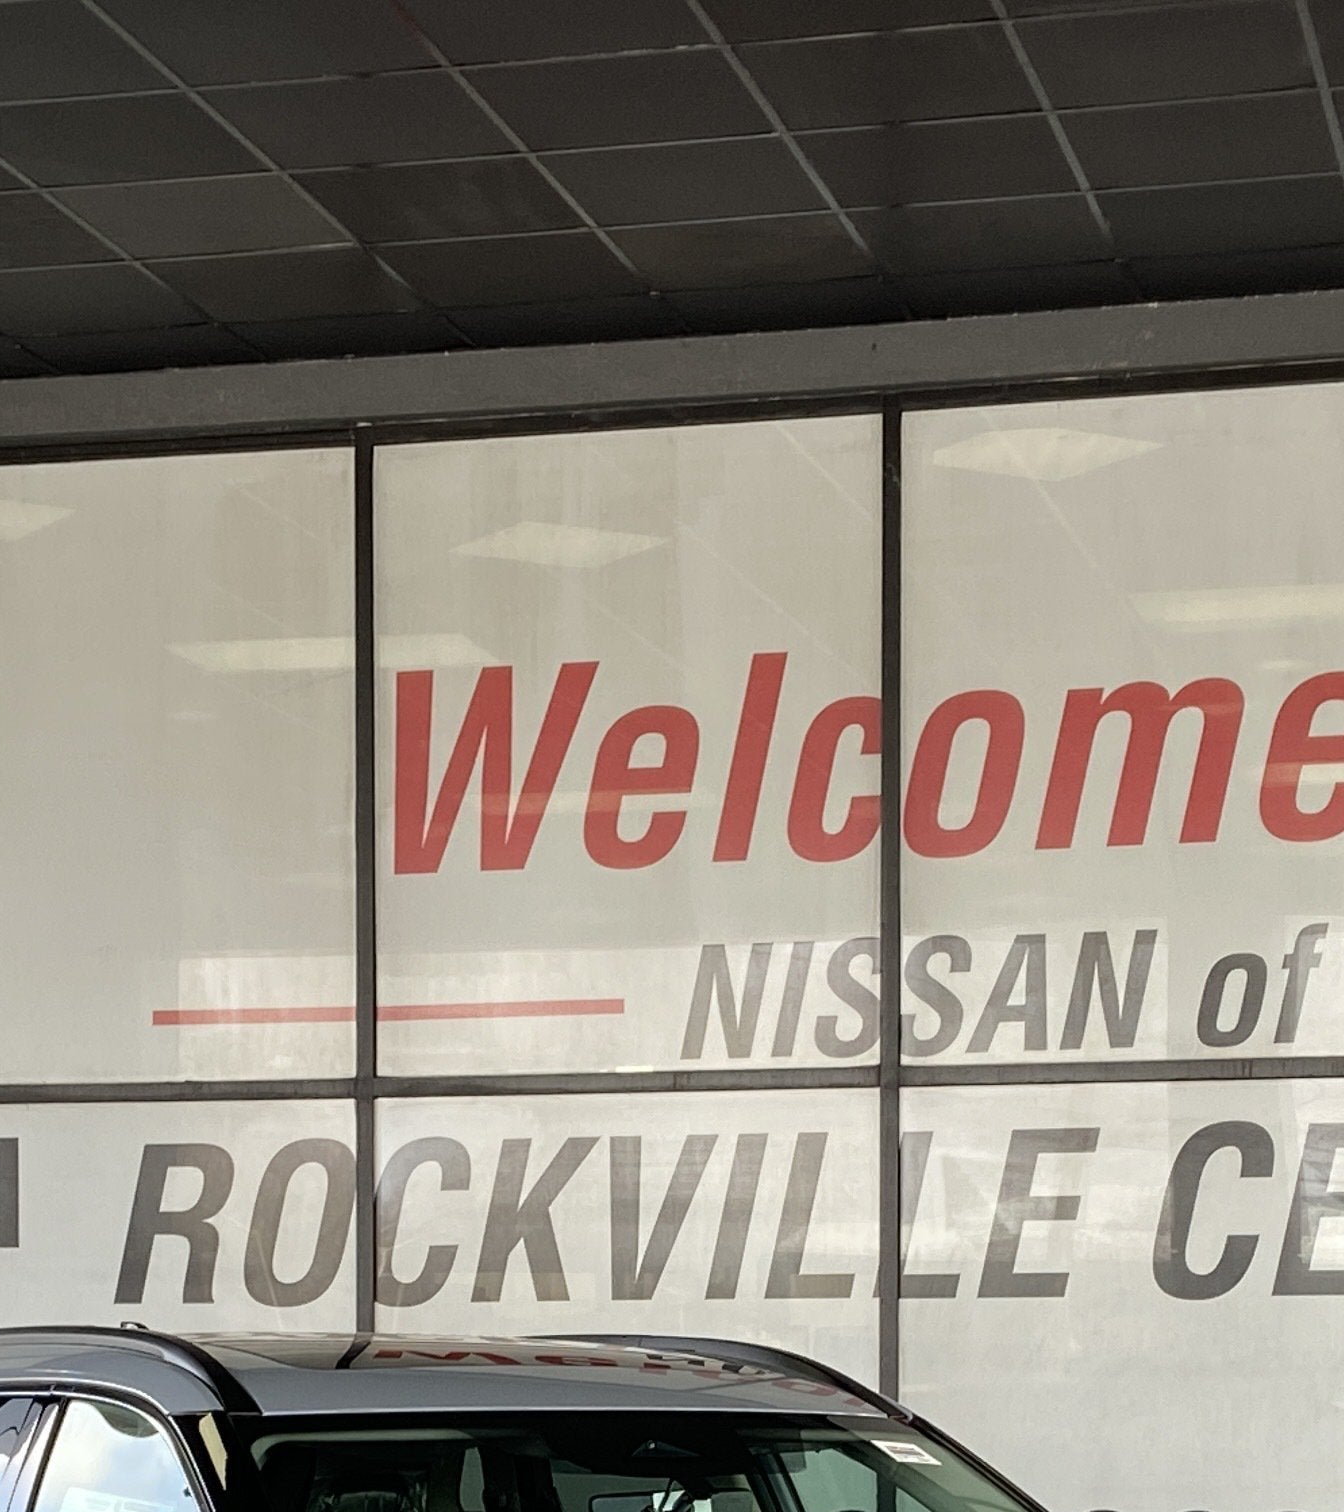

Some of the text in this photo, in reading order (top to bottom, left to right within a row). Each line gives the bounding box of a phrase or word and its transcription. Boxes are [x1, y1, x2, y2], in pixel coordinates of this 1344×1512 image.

[679, 922, 1329, 1060] NISSAN of
[113, 1126, 1101, 1308] ROCKVILLE
